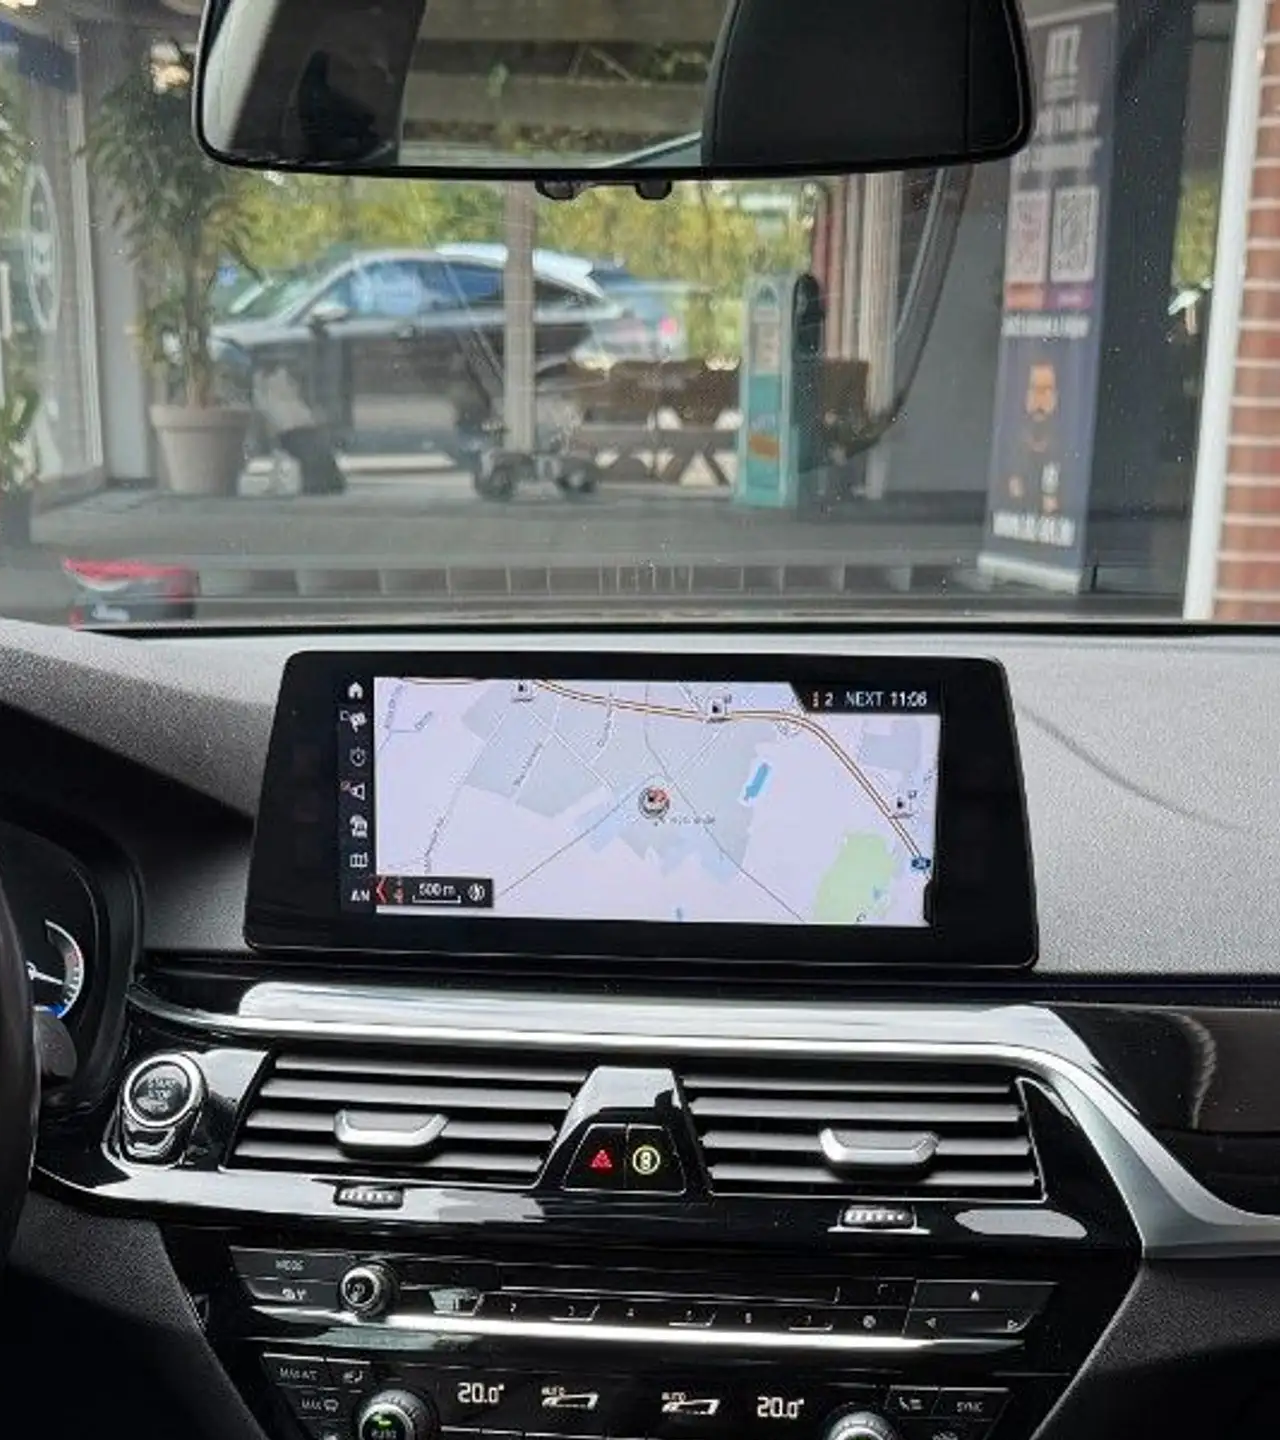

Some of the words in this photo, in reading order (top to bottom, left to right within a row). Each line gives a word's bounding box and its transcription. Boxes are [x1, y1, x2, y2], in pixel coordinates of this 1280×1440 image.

[824, 693, 834, 707] 2
[845, 691, 884, 707] NEXT
[890, 691, 928, 707] 11:06
[419, 883, 442, 897] 500
[956, 1401, 984, 1413] SYNC
